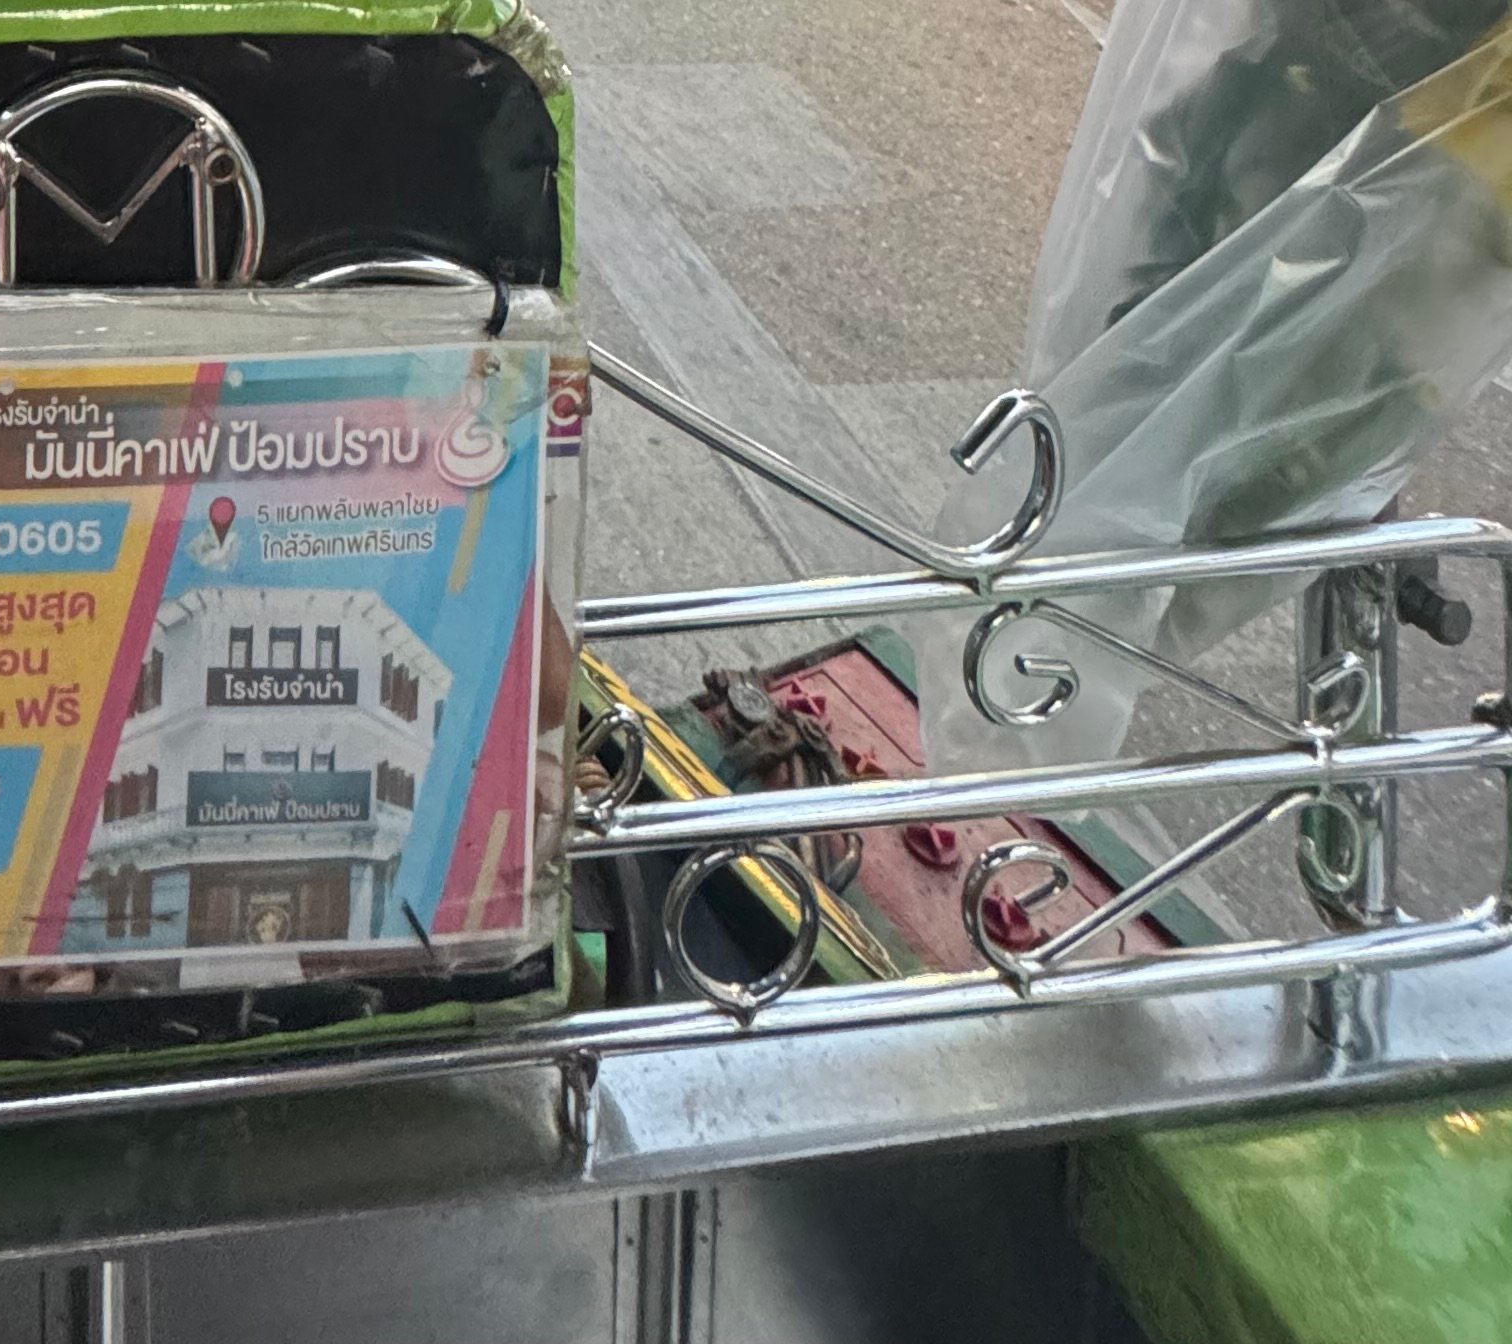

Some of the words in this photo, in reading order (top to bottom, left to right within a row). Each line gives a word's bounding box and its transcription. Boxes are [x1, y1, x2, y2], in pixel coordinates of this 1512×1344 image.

[26, 413, 218, 480] มันนี่คาเฟ่
[228, 416, 420, 472] ป้อมปราบ
[258, 505, 270, 524] 5
[276, 491, 440, 523] แยกพลับพลาไชย
[262, 526, 433, 561] ใกล้วัดเทพศิรินทร์
[224, 673, 344, 700] โรงรับจำนำ
[16, 683, 82, 728] ฟรี
